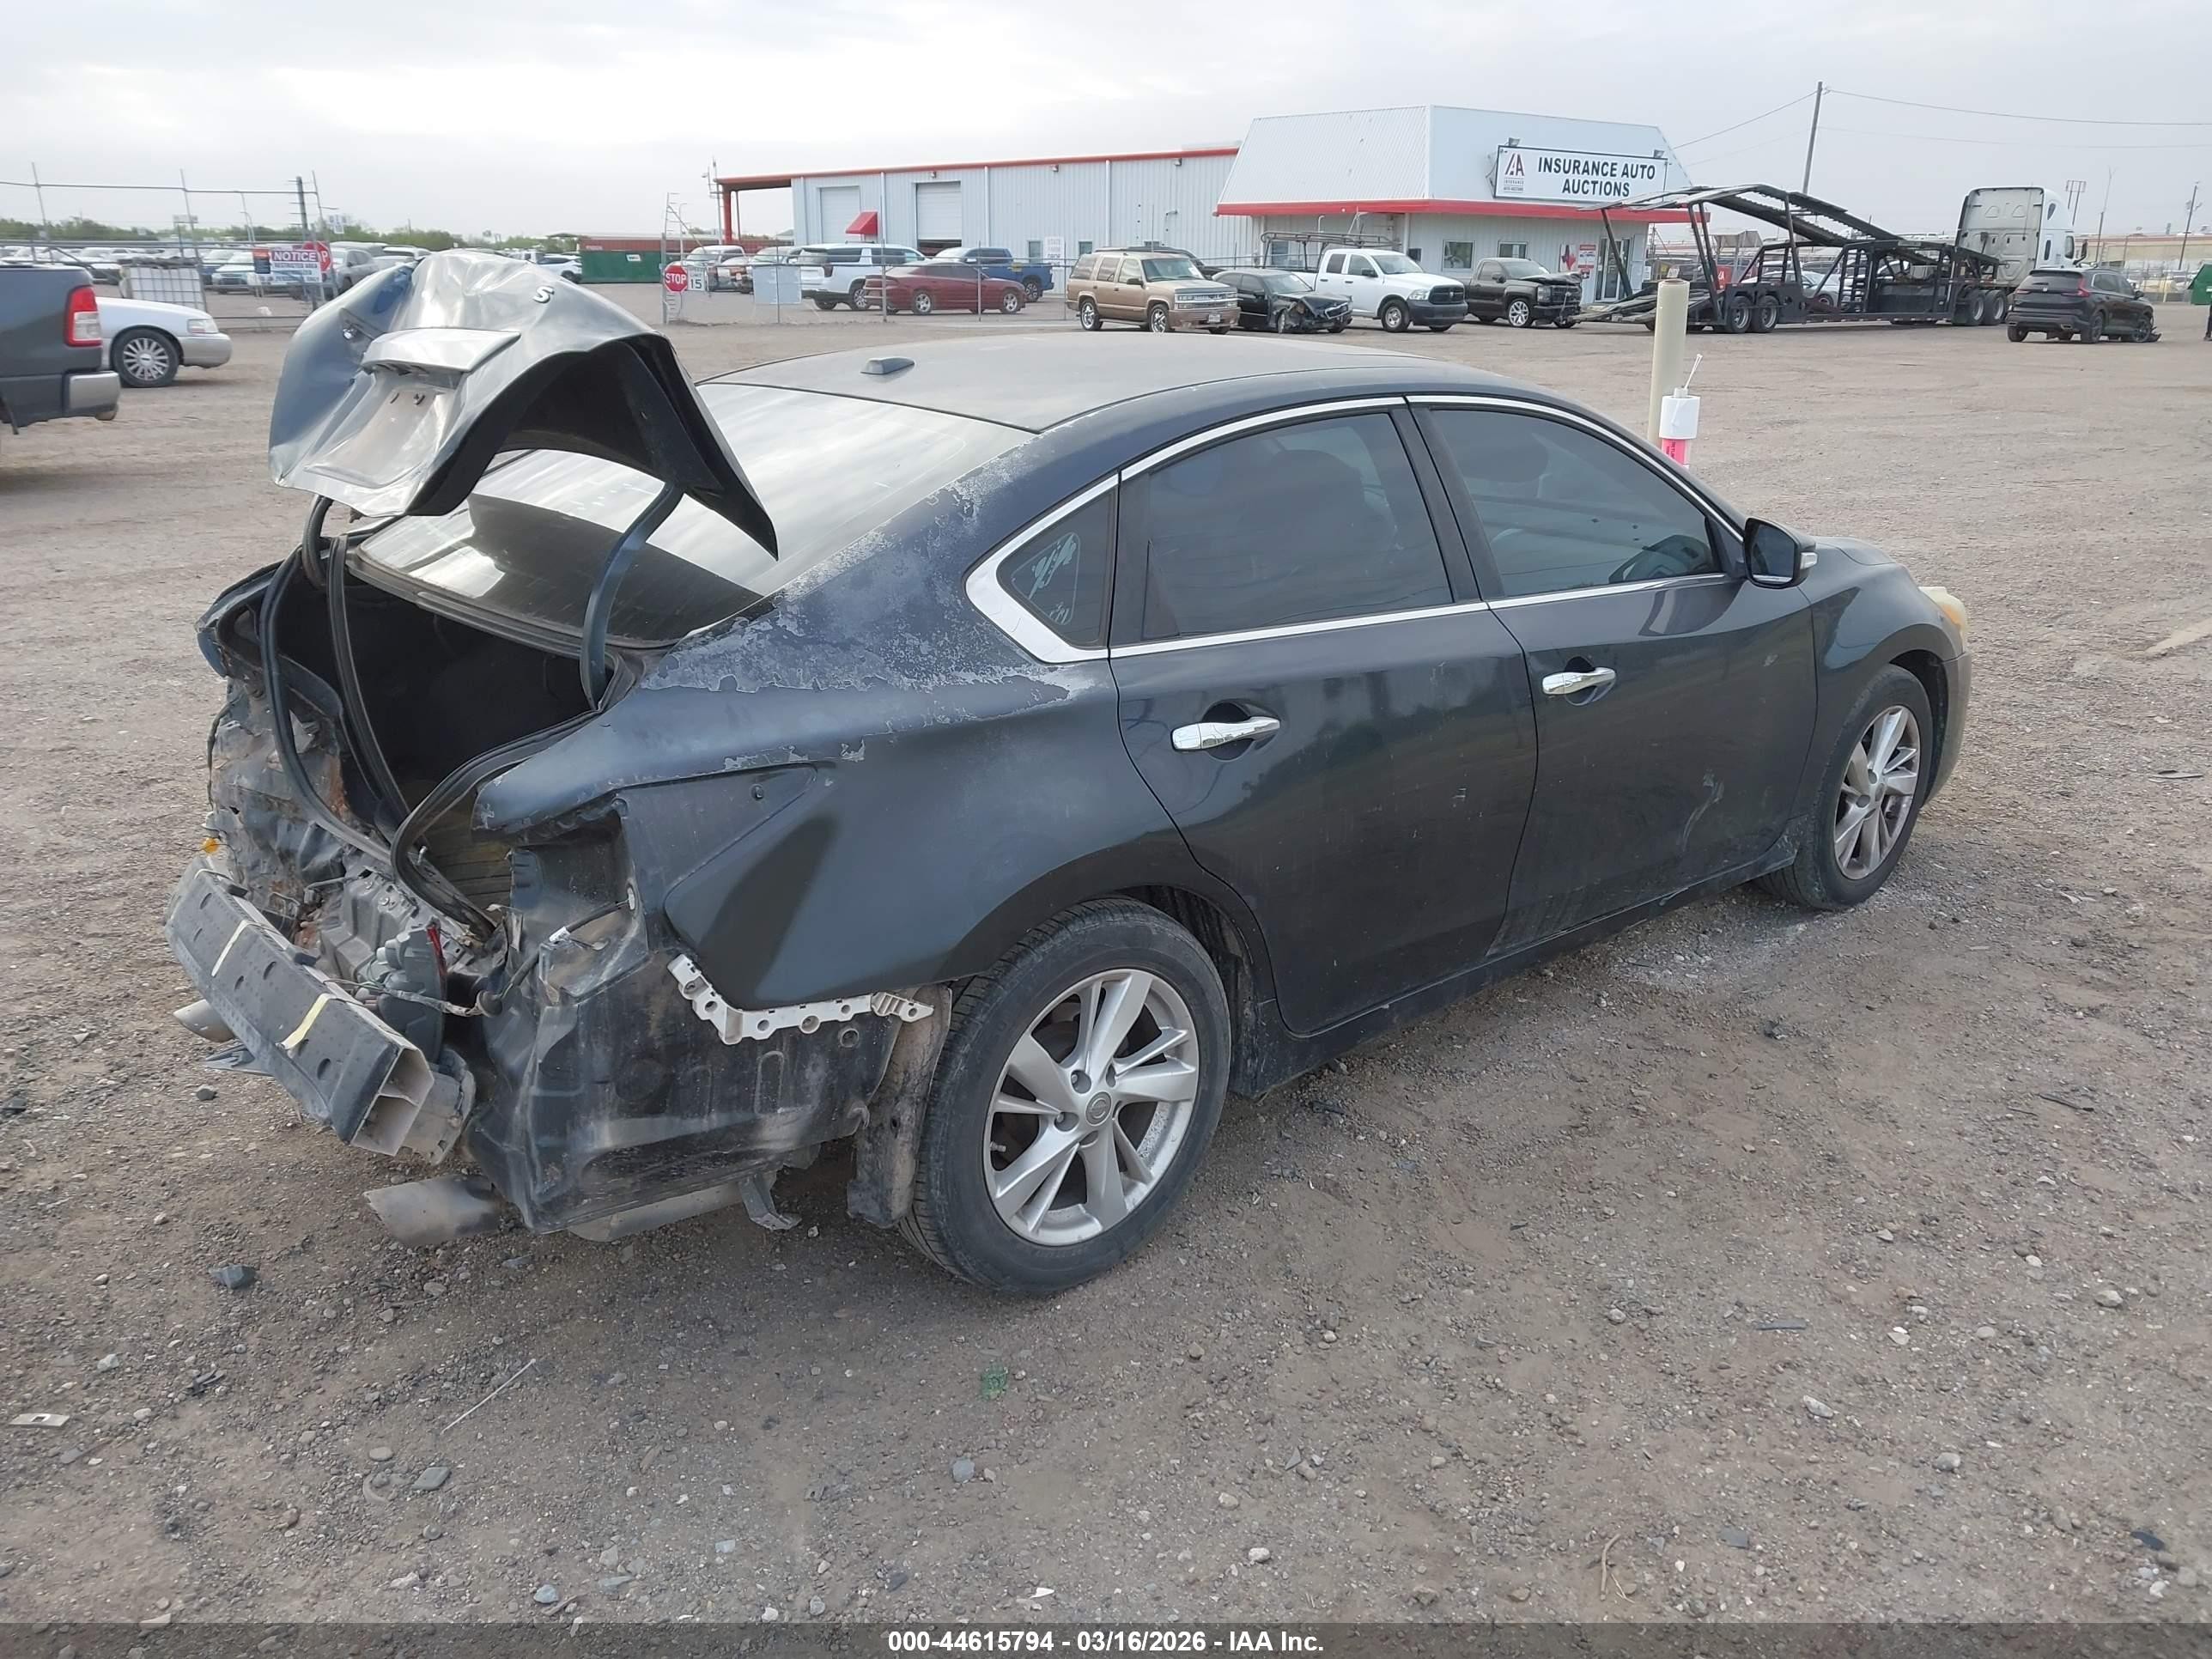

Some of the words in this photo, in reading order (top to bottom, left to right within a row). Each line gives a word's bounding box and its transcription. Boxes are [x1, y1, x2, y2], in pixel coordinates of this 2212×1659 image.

[1538, 156, 1618, 177] INSURANCE
[1621, 163, 1656, 179] AUTO
[1562, 178, 1630, 197] AUCTIONS
[274, 251, 317, 261] NOTICE
[665, 273, 687, 284] STOP
[690, 279, 702, 289] 15
[532, 286, 555, 304] S
